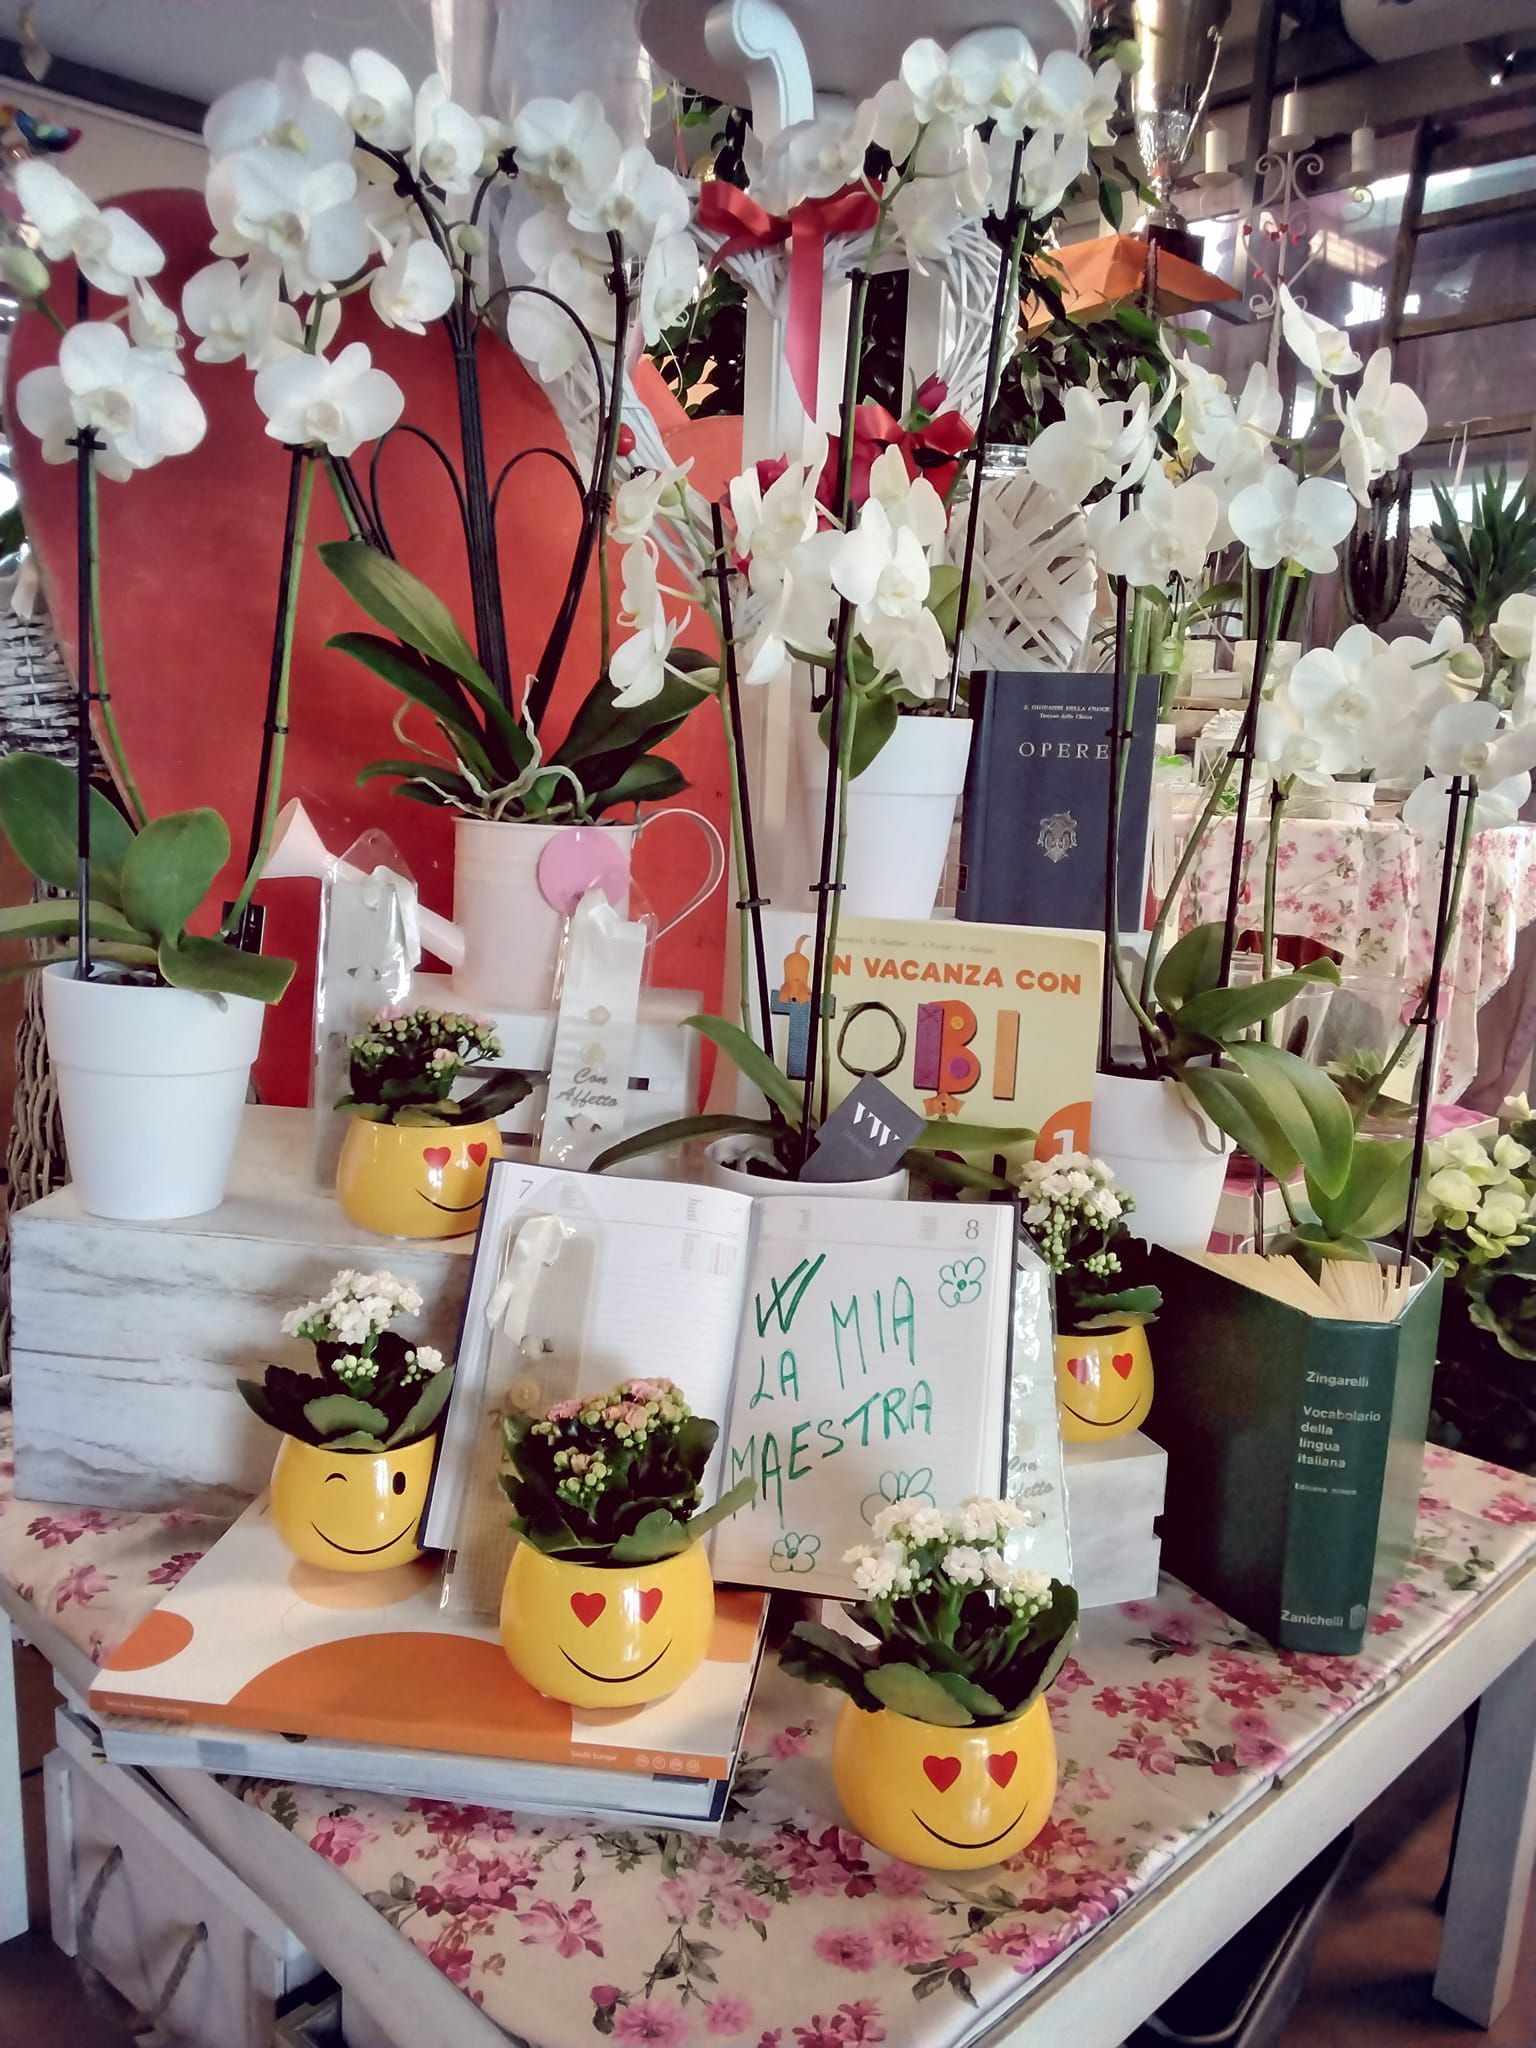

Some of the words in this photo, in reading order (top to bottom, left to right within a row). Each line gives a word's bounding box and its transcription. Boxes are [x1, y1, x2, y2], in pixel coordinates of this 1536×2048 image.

[1018, 741, 1110, 760] OPERE
[863, 956, 1004, 988] VACANZA
[1015, 969, 1082, 995] CON
[573, 1066, 609, 1086] Con
[554, 1086, 618, 1109] Affetto
[1053, 1128, 1075, 1157] 1
[518, 1179, 534, 1199] 7
[964, 1218, 980, 1240] 8
[830, 1275, 916, 1390] MIA
[748, 1348, 799, 1410] LA
[1305, 1370, 1370, 1389] Zingarelli
[1303, 1405, 1382, 1423] Vocabolario
[1300, 1422, 1334, 1437] della
[731, 1379, 933, 1530] MAESTRA
[1299, 1437, 1341, 1454] lingua
[1297, 1453, 1347, 1469] italiana
[1280, 1609, 1344, 1628] Zanichelli
